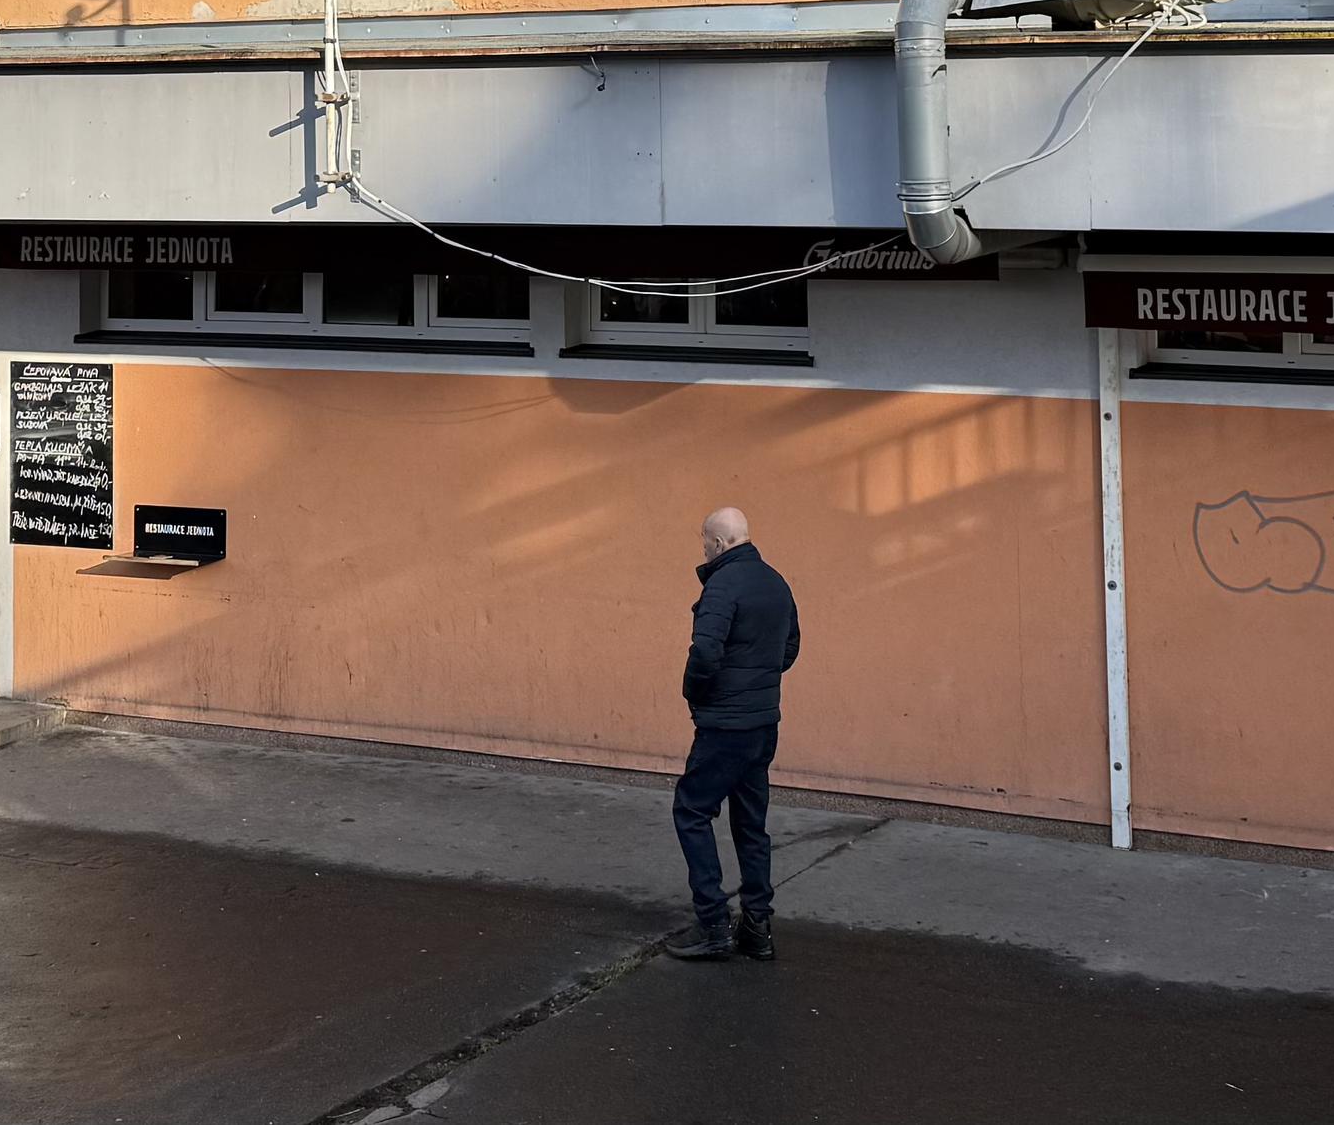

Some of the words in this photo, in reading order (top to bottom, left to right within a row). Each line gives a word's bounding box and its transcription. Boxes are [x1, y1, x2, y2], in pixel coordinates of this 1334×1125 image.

[20, 236, 134, 263] RESTAURACE
[145, 237, 234, 264] JEDNOTA
[1137, 288, 1308, 323] RESTAURACE
[145, 523, 185, 535] RESTAURACE
[186, 525, 214, 537] JEDNOTA
